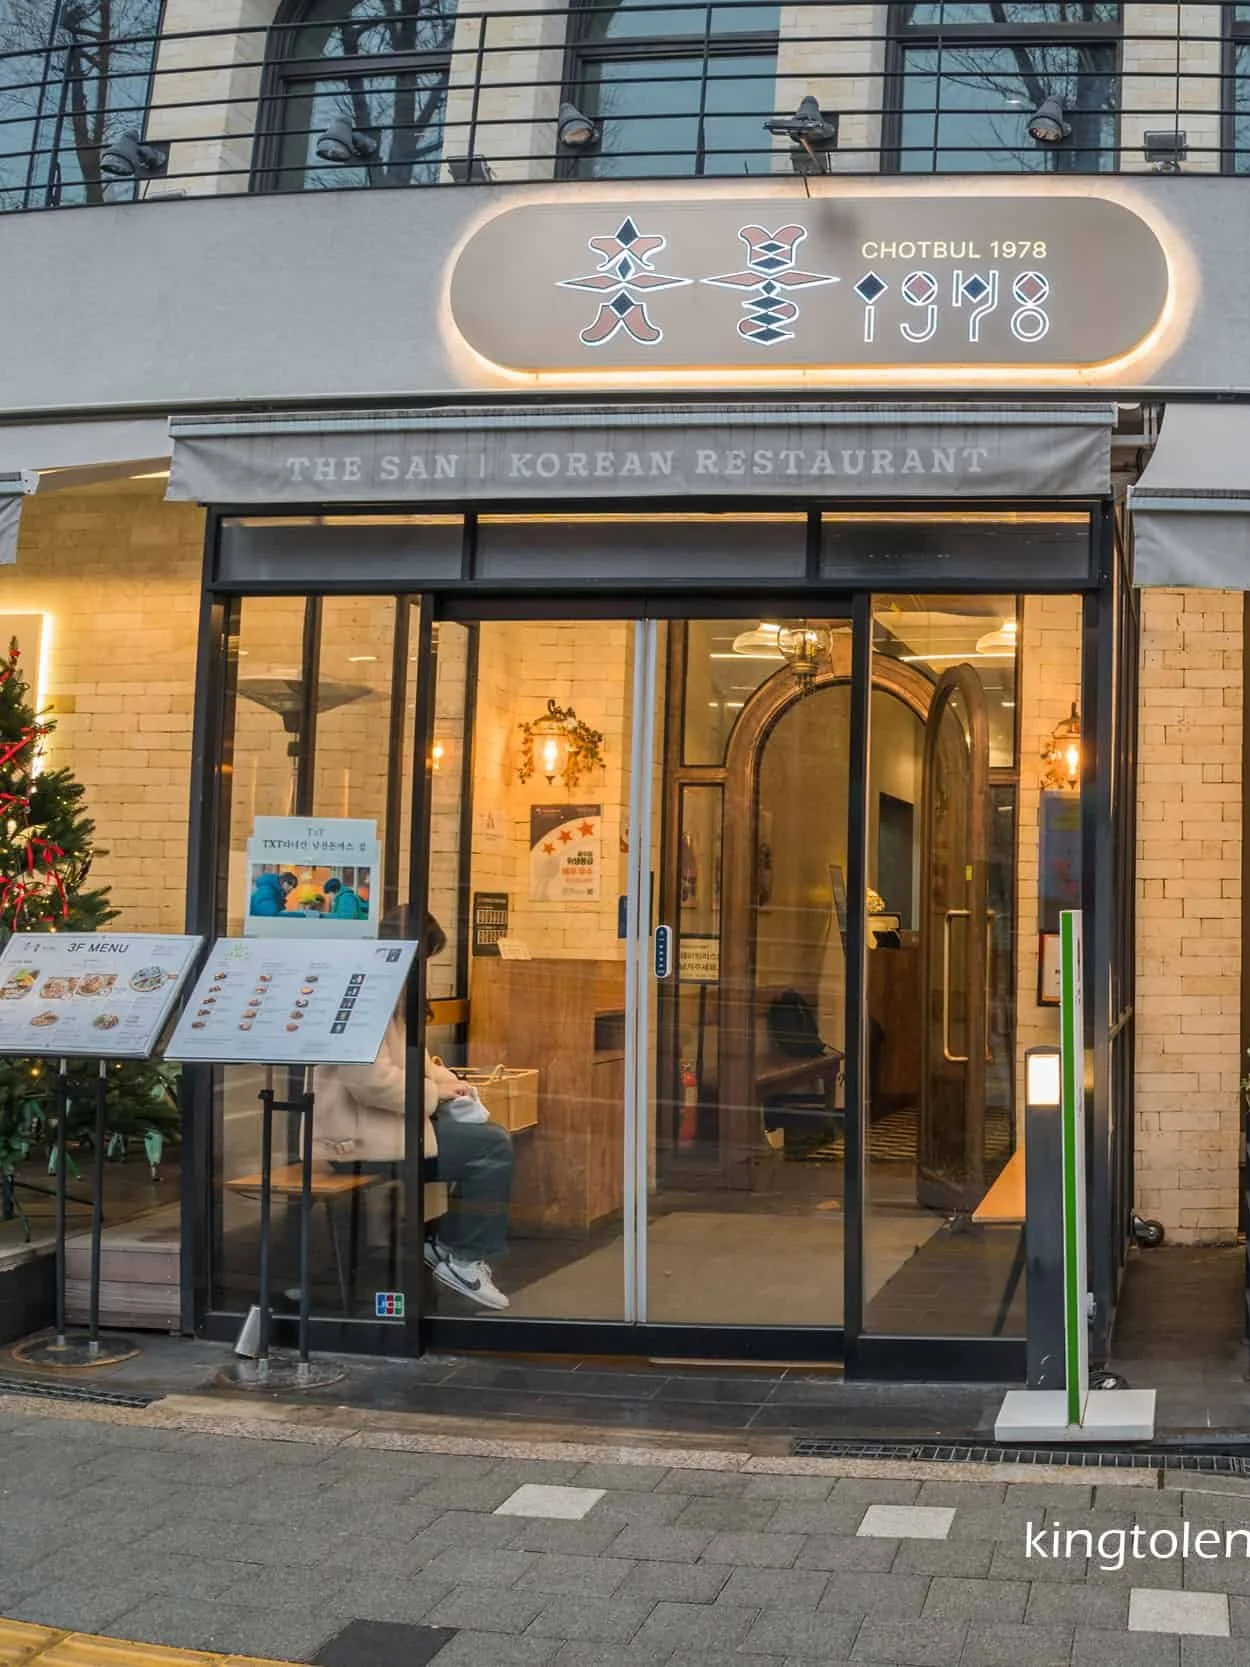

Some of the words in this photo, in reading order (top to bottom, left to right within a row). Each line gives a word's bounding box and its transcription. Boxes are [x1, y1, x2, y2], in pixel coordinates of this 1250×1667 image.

[861, 240, 982, 260] CHOTBUL
[990, 240, 1048, 260] 1978
[853, 269, 1051, 343] 1978
[286, 455, 363, 483] THE
[380, 453, 459, 481] SAN
[508, 449, 677, 479] KOREAN
[694, 446, 990, 477] RESTAURANT
[67, 943, 86, 953] 3F
[88, 943, 129, 954] MENU
